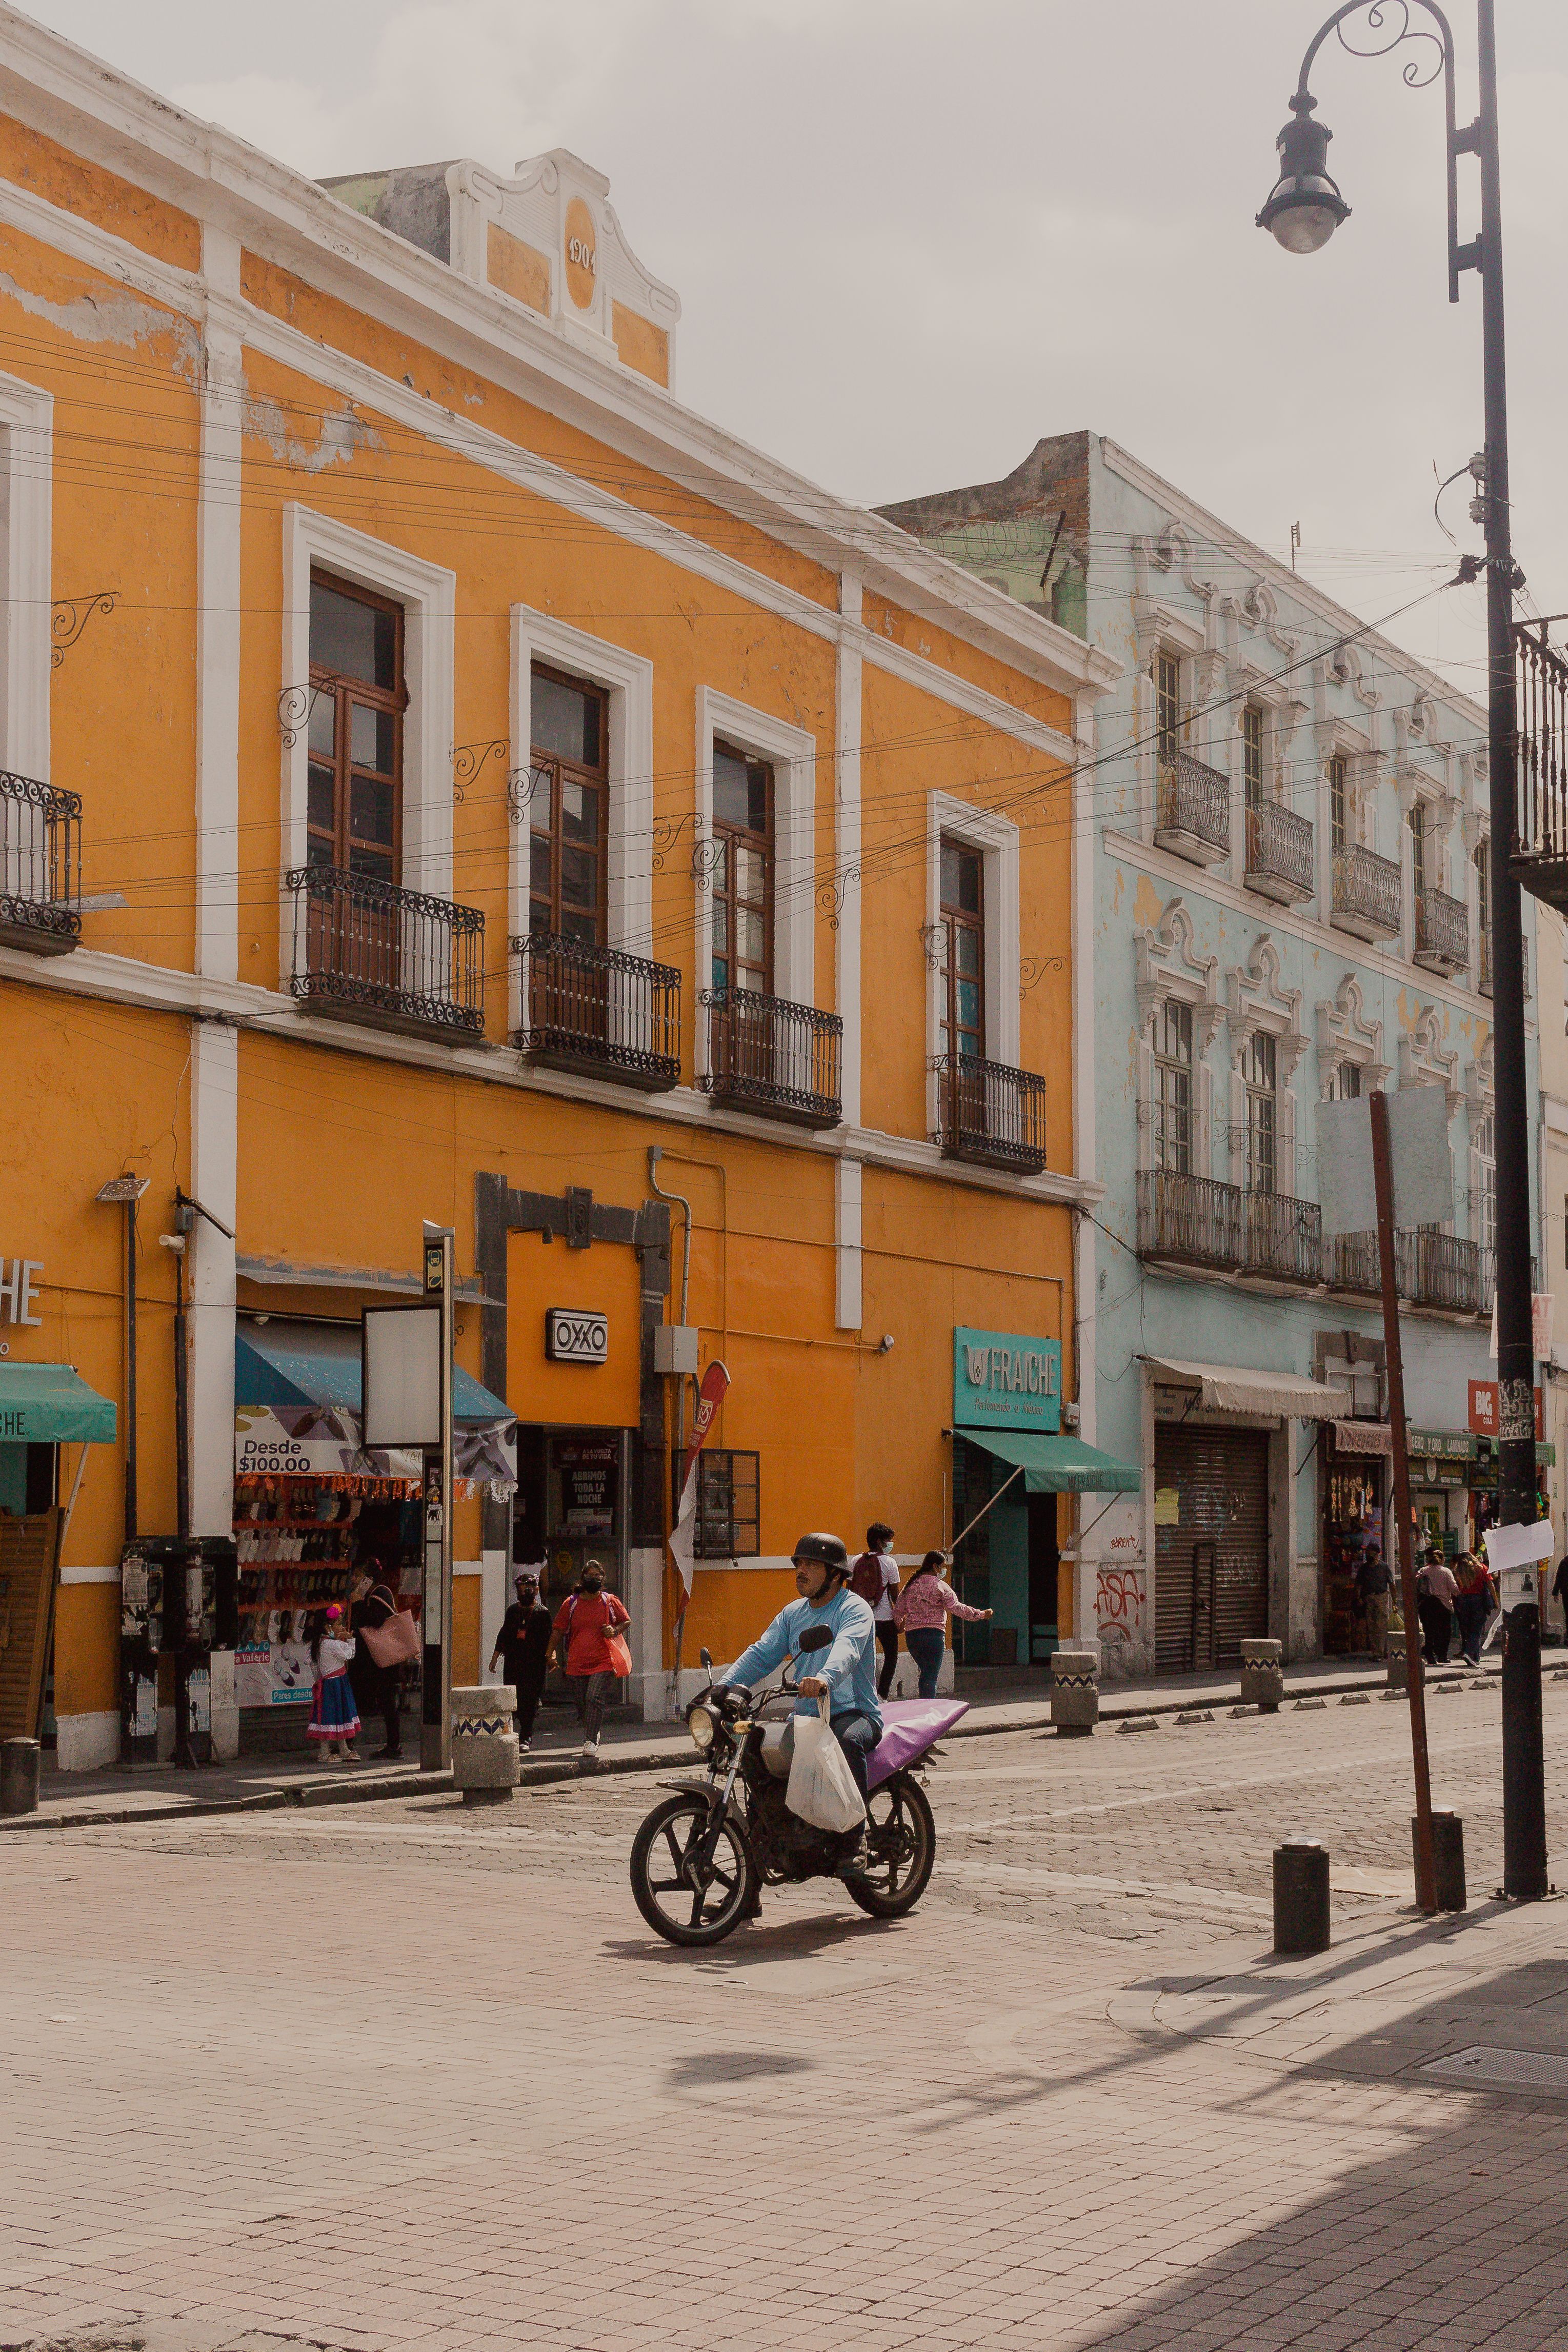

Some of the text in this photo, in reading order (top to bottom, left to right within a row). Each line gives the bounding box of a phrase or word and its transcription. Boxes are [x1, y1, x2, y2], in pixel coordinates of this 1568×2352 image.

[557, 1321, 606, 1351] OXXO
[991, 1348, 1057, 1395] FRAICHE
[975, 1397, 1010, 1413] Perfumando
[1475, 1391, 1493, 1416] BIG
[1483, 1416, 1493, 1424] COLA
[244, 1440, 302, 1454] Desde
[239, 1455, 311, 1472] $100.00
[572, 1471, 607, 1481] ABRIMOS
[574, 1483, 605, 1493] TODA LA
[577, 1494, 602, 1504] NOCHE
[242, 1654, 270, 1662] Valerie
[273, 1690, 313, 1700] Pares desde
